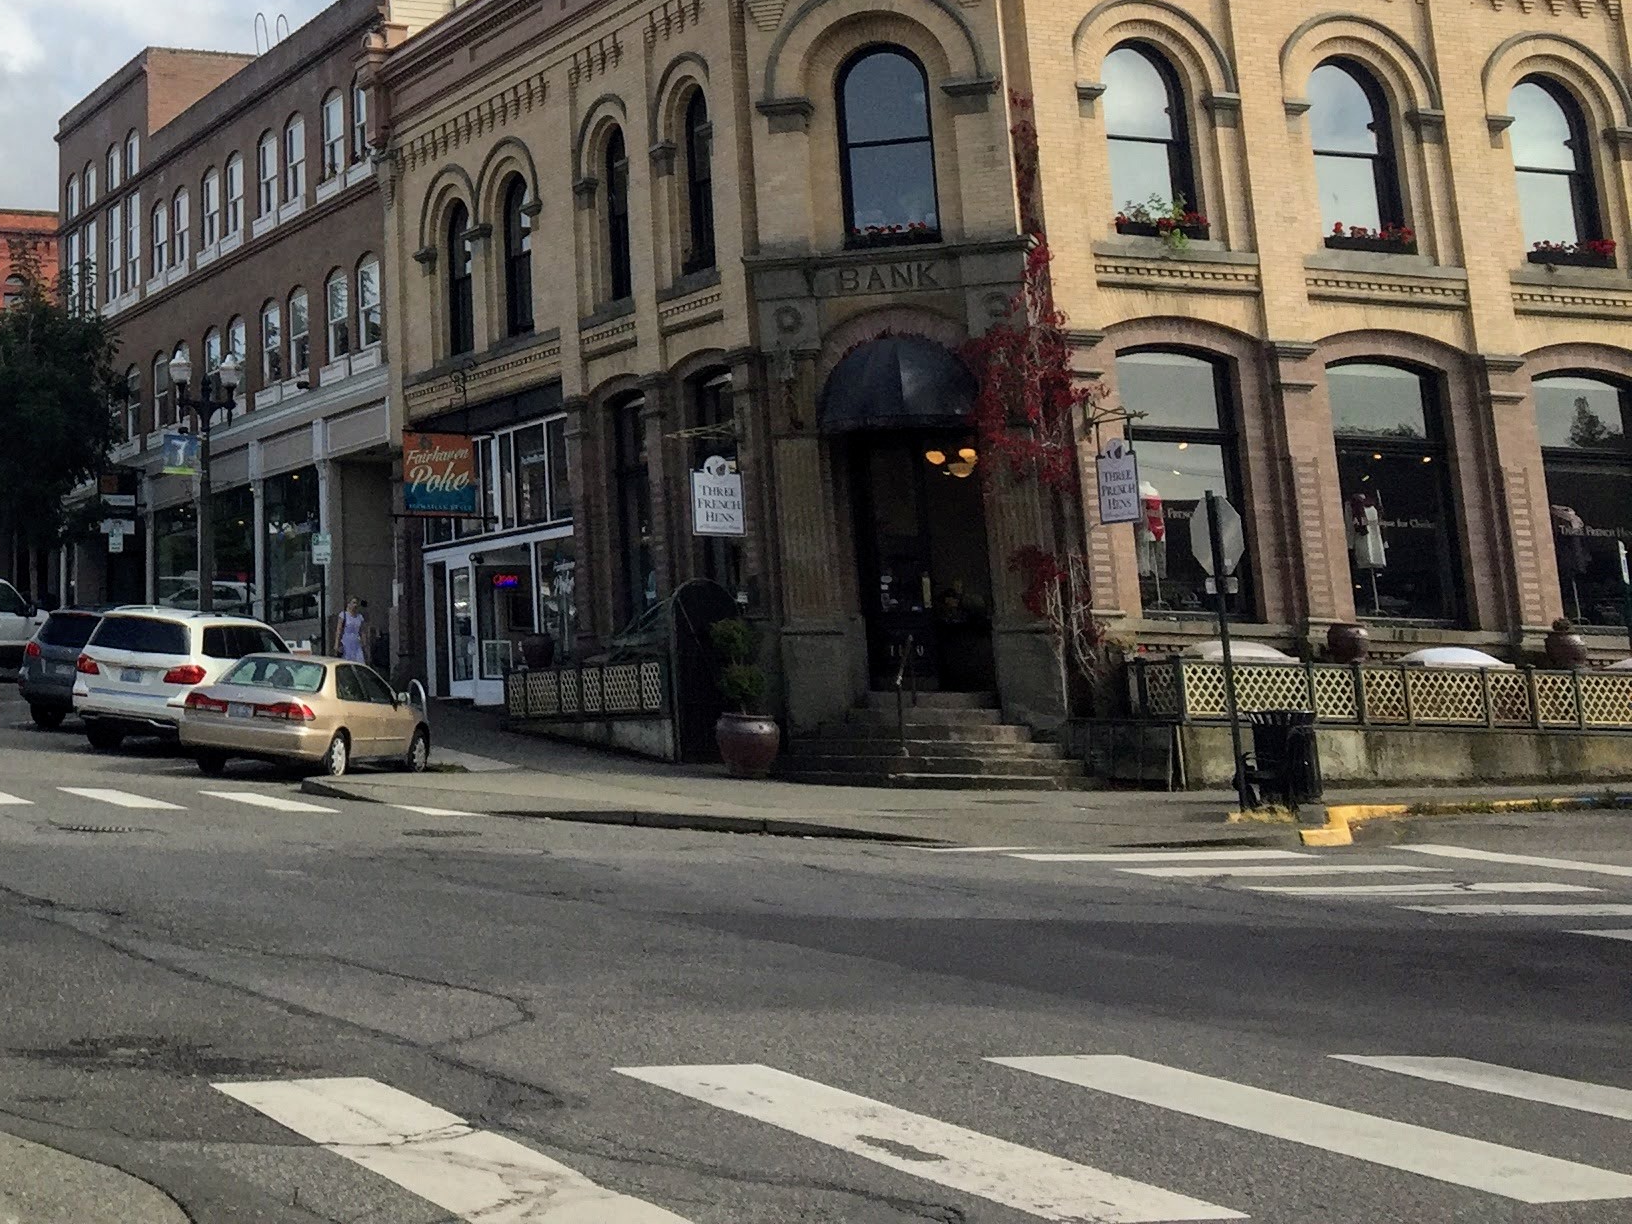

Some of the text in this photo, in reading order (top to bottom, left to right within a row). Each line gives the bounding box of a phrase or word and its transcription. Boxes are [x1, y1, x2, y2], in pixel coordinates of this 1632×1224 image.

[837, 262, 940, 293] BANK
[407, 445, 469, 465] Fairhaven
[409, 461, 470, 493] Poke
[1103, 470, 1132, 482] THREE
[699, 485, 735, 496] THREE
[1101, 483, 1136, 497] FRENCH
[697, 498, 742, 509] FRENCH
[706, 511, 735, 522] HENS
